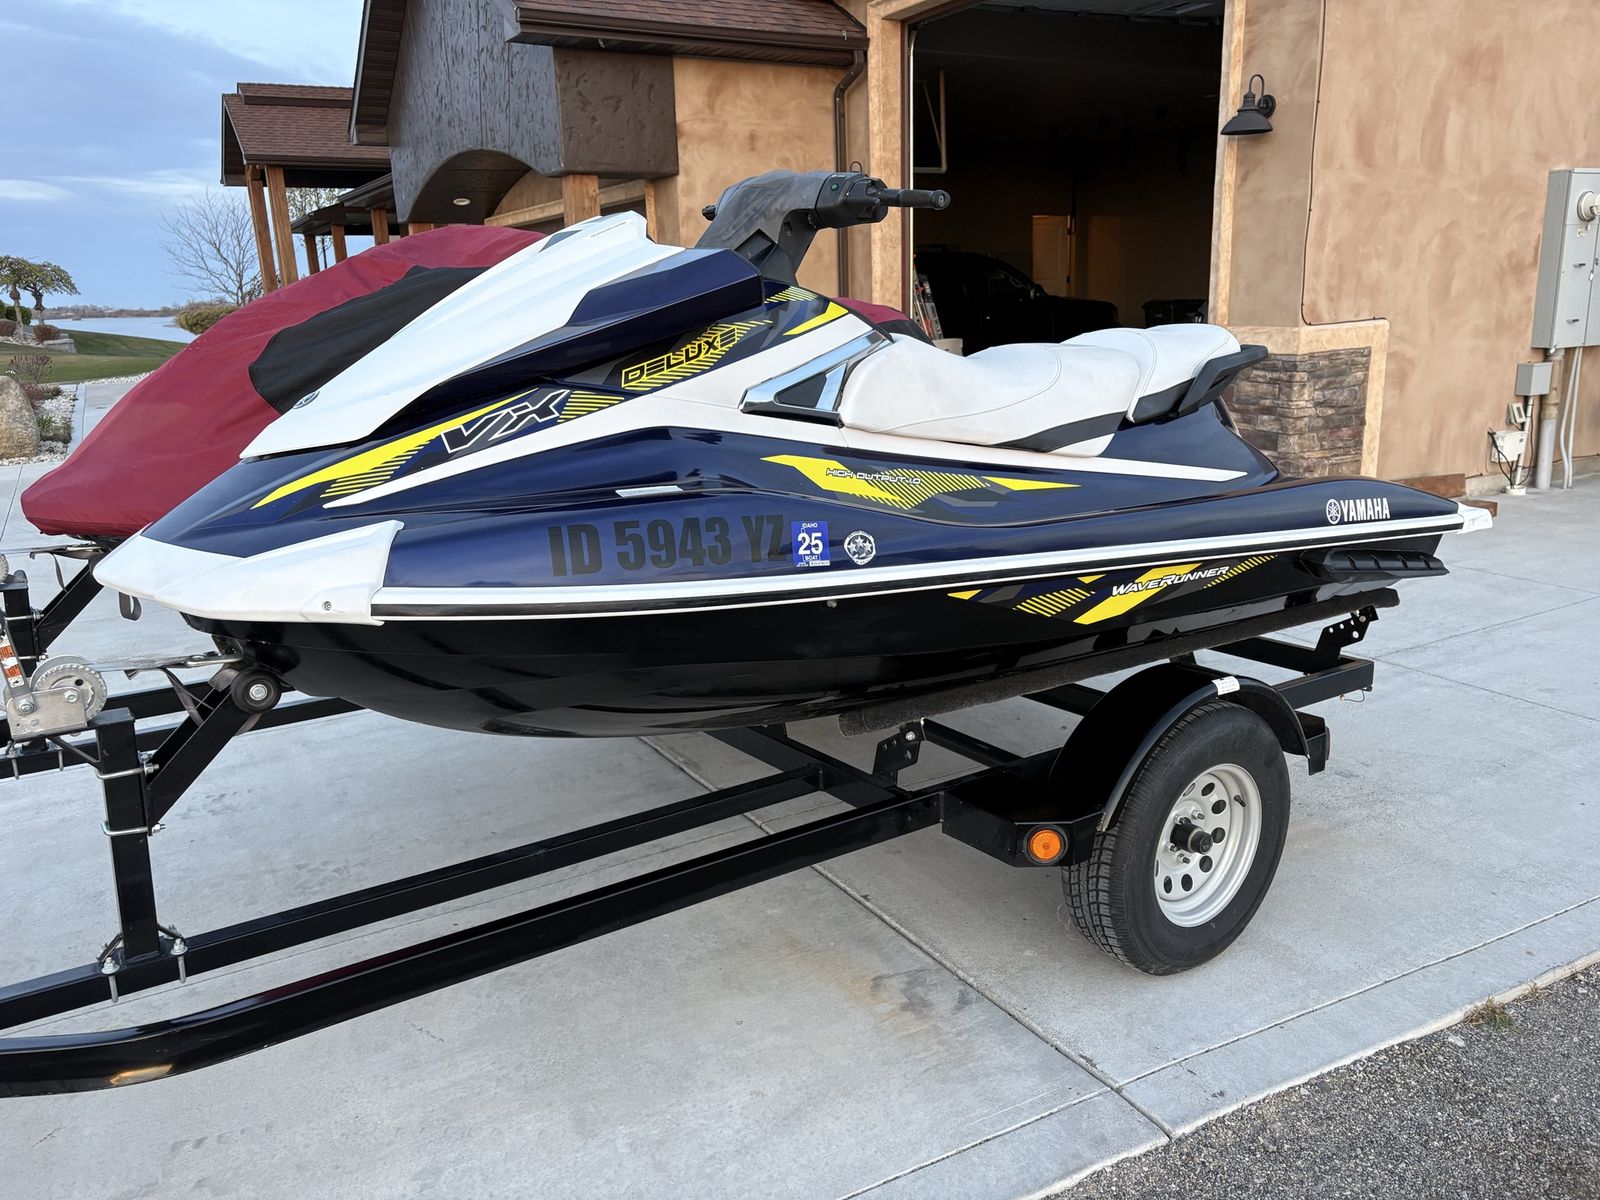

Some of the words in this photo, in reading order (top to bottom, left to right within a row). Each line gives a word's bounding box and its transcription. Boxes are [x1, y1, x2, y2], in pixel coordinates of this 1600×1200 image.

[621, 326, 738, 389] DELUXE
[440, 389, 571, 454] VX
[826, 467, 854, 479] HIGH
[856, 472, 907, 483] OUTPUT
[1340, 497, 1391, 522] YAMAHA
[547, 524, 603, 577] ID
[613, 516, 732, 571] 5943
[741, 513, 787, 563] YZ
[797, 532, 824, 555] 25
